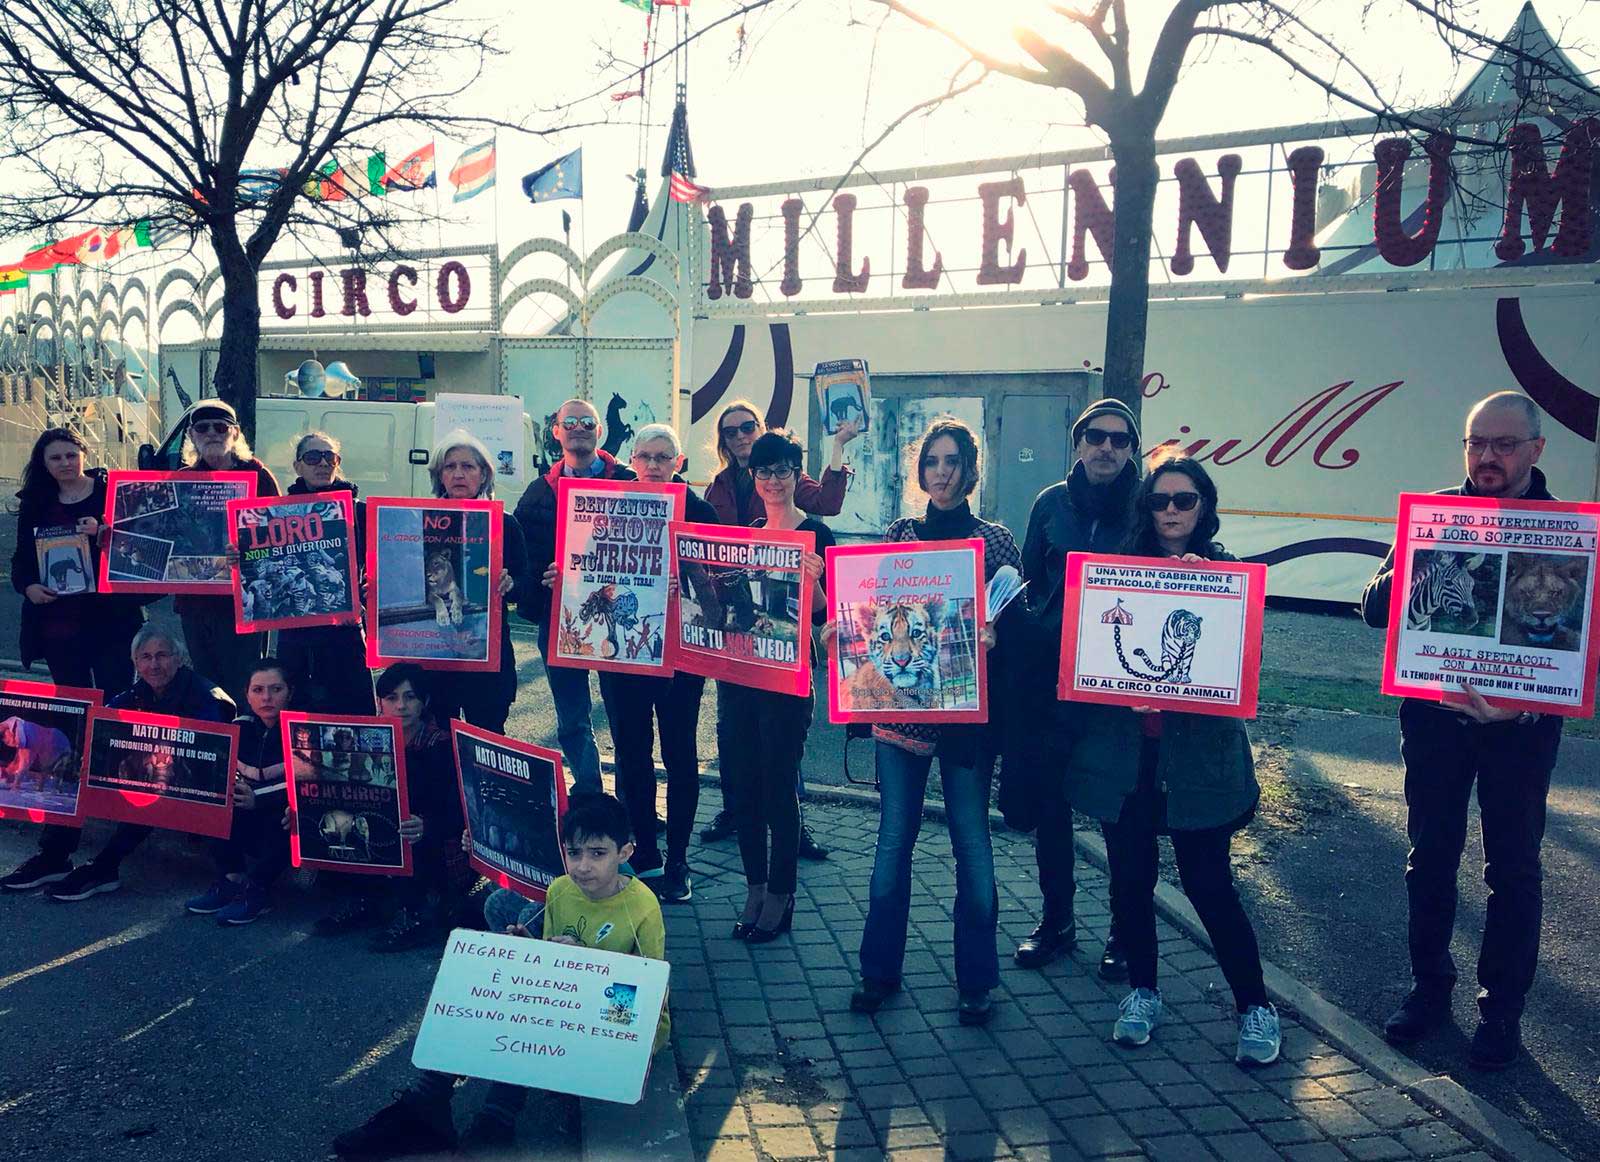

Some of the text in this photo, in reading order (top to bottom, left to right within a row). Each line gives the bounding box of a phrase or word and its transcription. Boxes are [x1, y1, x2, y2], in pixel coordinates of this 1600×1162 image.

[707, 116, 1600, 301] MILLENNIUM
[272, 260, 472, 320] CIRCO
[574, 496, 667, 517] BENVENUTI
[424, 515, 451, 530] NO
[574, 514, 592, 523] ALLO
[592, 515, 666, 545] SHOW
[1432, 513, 1579, 531] IL TUO DIVERTIMENTO
[246, 512, 323, 549] LORO
[423, 535, 441, 543] CON
[1416, 527, 1434, 539] LA
[1441, 528, 1479, 541] LORO
[1485, 531, 1584, 548] SOFFERENZA
[244, 537, 341, 561] NON SI DIVERTONO
[596, 542, 663, 576] TRISTE
[679, 539, 799, 569] COSA IL CIRCO VUOLE
[570, 551, 598, 572] PIÙ
[893, 558, 914, 570] NO
[858, 575, 952, 589] AGLI ANIMALI
[1095, 567, 1233, 584] UNA VITA IN GABBIA NON È
[869, 592, 944, 607] NEI CIRCHI
[683, 623, 706, 646] CHE
[707, 628, 723, 650] TU
[757, 637, 795, 663] VEDA
[1422, 644, 1553, 667] NO AGLI SPETTACOLI
[1443, 659, 1466, 670] CON
[1471, 661, 1525, 676] ANIMALI
[1081, 677, 1231, 699] NO AL CIRCO CON ANIMALI
[1401, 669, 1408, 679] IL
[1409, 670, 1445, 682] TENDONE
[1446, 674, 1454, 684] DI
[1456, 675, 1468, 685] UN
[1468, 676, 1495, 688] CIRCO
[1498, 679, 1513, 690] NON
[1523, 683, 1535, 693] UN
[1536, 684, 1573, 697] HABITAT
[132, 724, 195, 745] NATO LIBERO
[109, 738, 153, 753] PRIGIONIERO
[154, 744, 160, 753] A
[176, 747, 185, 757] IN
[186, 749, 196, 759] UN
[197, 751, 217, 762] CIRCO
[474, 744, 530, 780] NATO LIBERO
[300, 783, 319, 798] NO
[342, 787, 392, 801] CIRCO
[453, 939, 517, 961] NEGARE
[524, 952, 542, 965] LA
[491, 968, 579, 993] È VIOLENZA
[471, 986, 582, 1011] NON SPETTACOLO
[433, 1003, 505, 1022] NESSUNO
[510, 1013, 555, 1028] NASCE
[560, 1020, 586, 1034] PER
[591, 1027, 640, 1043] ESSERE
[490, 1034, 567, 1058] SCHIAVO
